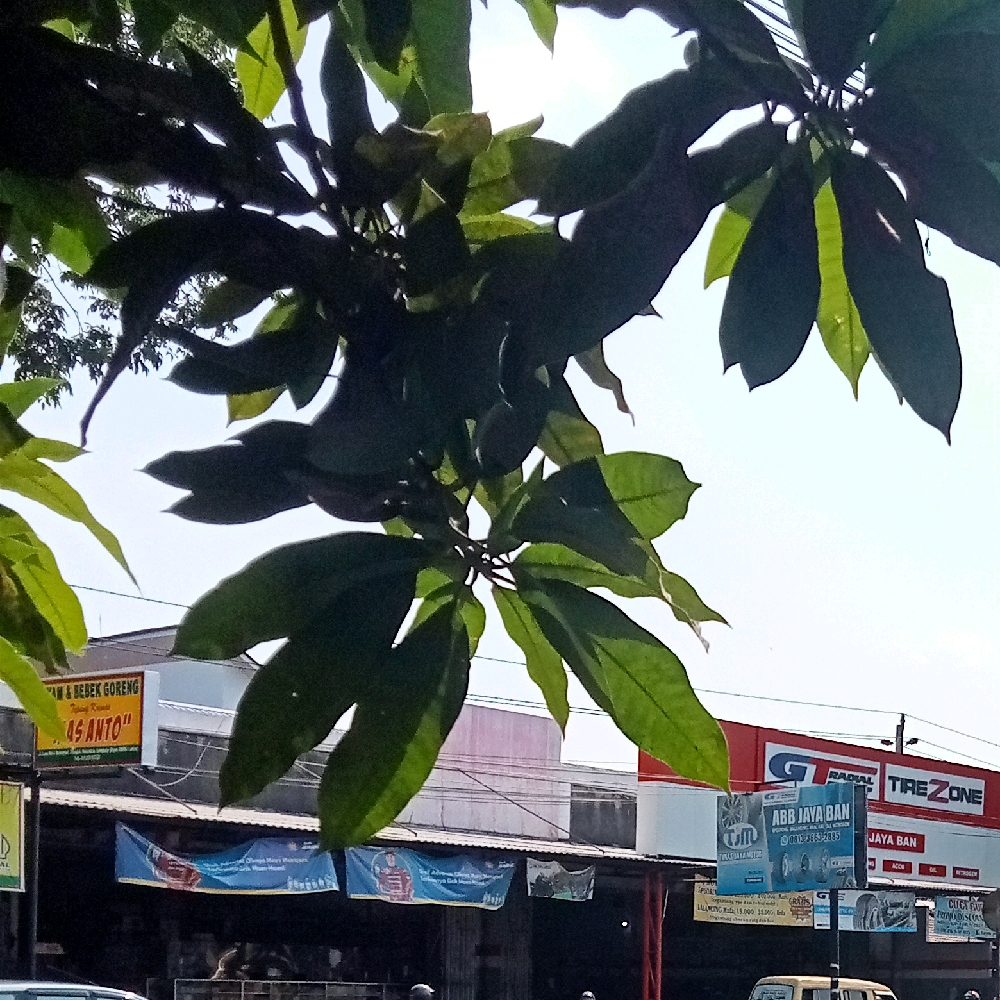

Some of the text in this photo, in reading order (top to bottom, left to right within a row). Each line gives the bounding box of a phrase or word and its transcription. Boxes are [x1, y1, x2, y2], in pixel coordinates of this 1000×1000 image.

[74, 682, 102, 699] BEBEK
[103, 679, 139, 697] GORENG
[769, 753, 877, 785] GT
[828, 770, 874, 786] RADIAL
[772, 803, 850, 827] ABB JAYA BAN
[868, 832, 917, 848] JAYA BAN
